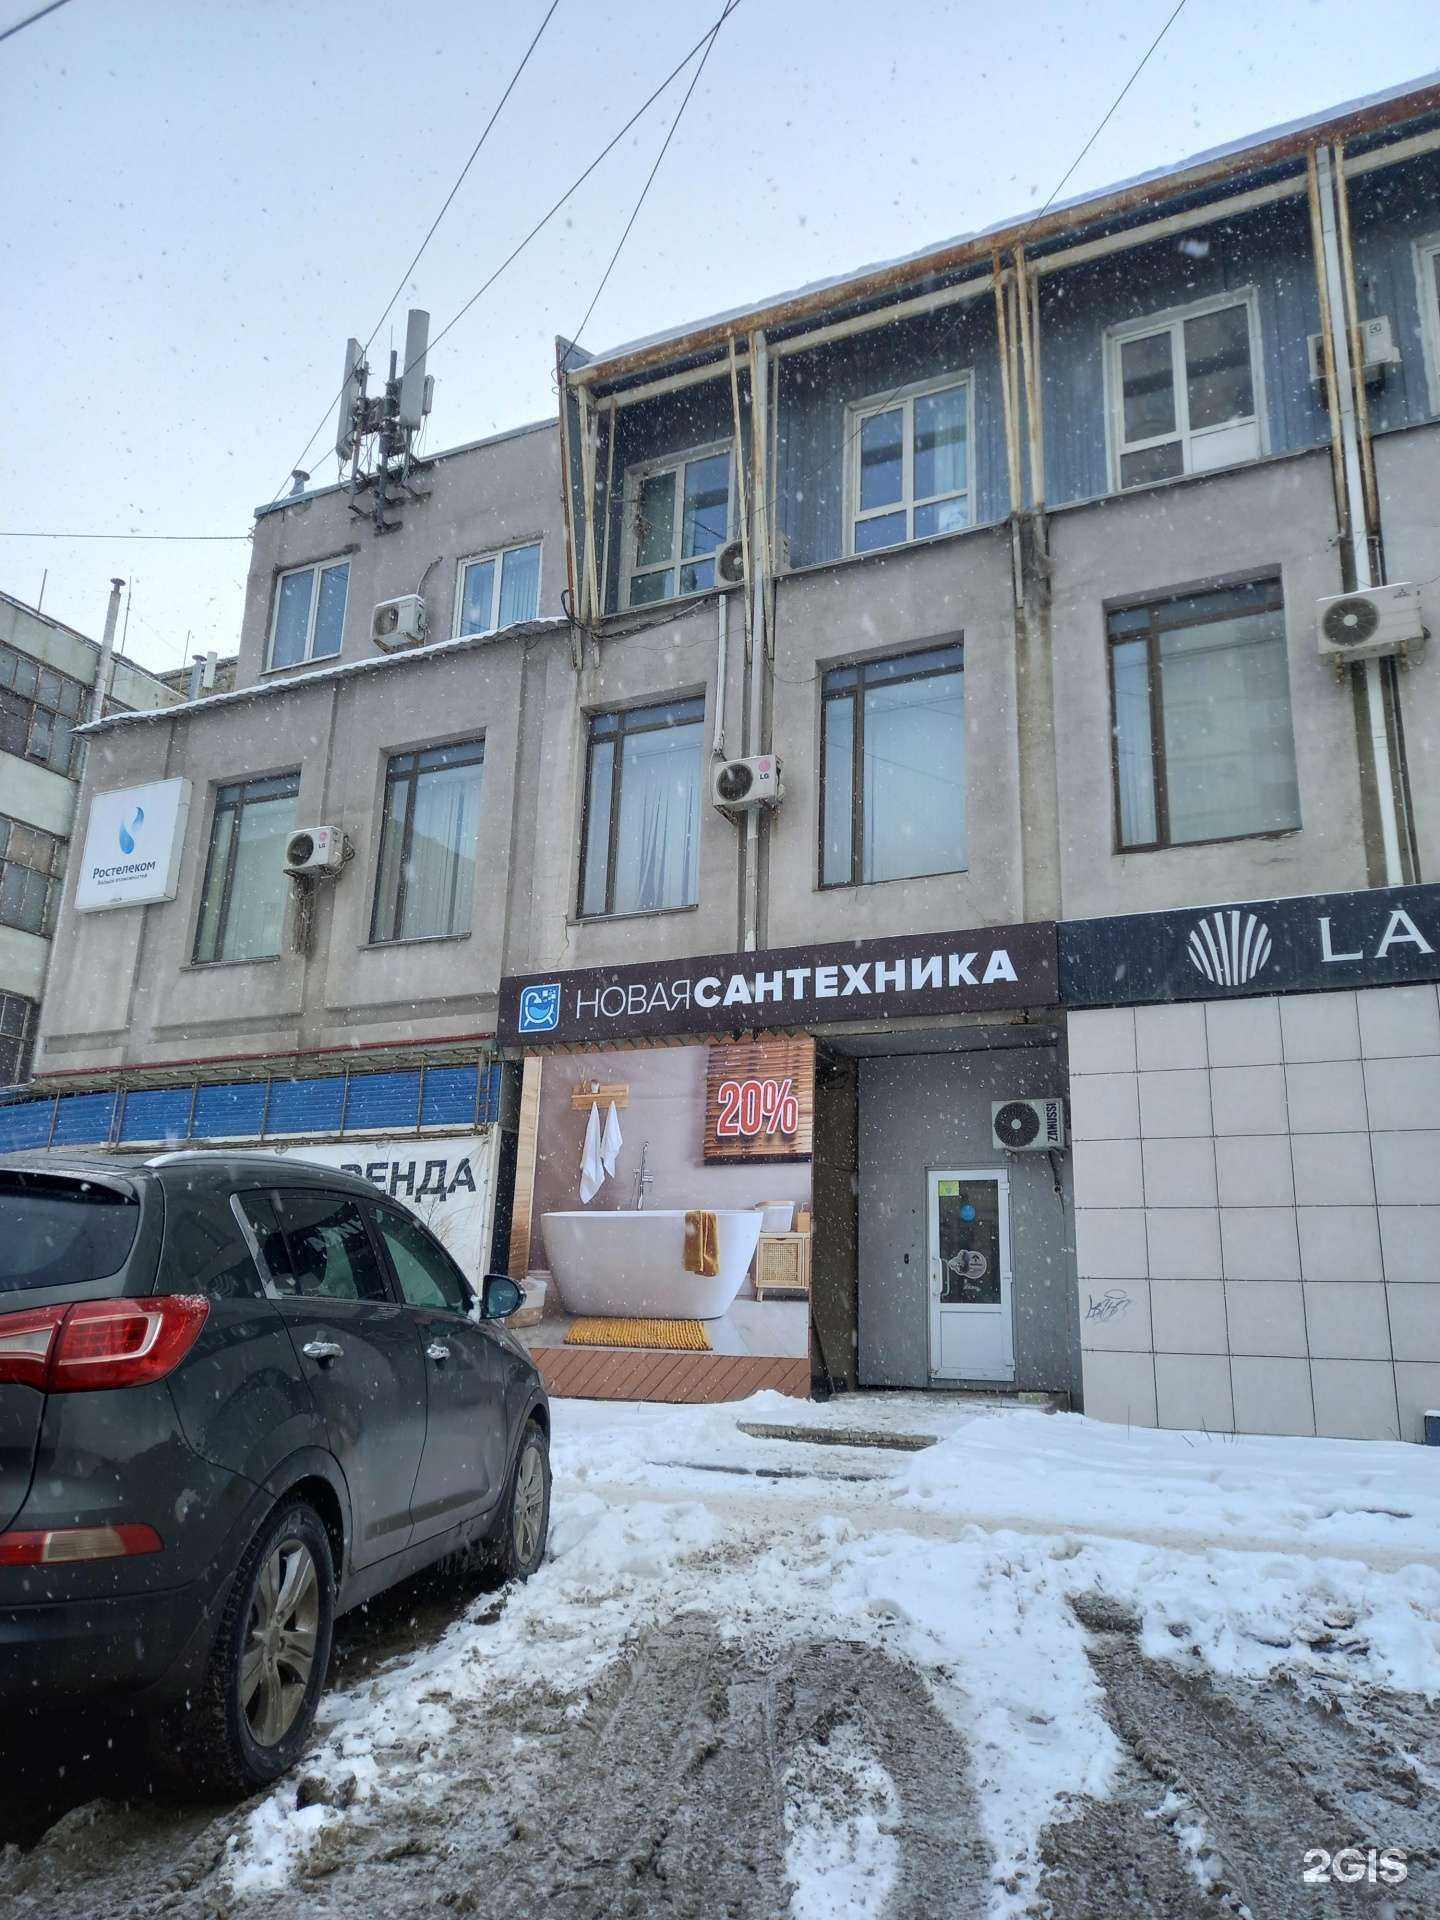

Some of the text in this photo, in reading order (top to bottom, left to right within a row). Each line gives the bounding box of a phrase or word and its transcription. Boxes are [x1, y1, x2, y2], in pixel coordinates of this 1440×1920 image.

[760, 772, 769, 780] LG
[92, 861, 156, 880] Ростелеком
[1317, 909, 1437, 962] LA
[717, 1078, 799, 1137] 20%
[1046, 1102, 1059, 1142] ZANUSSI
